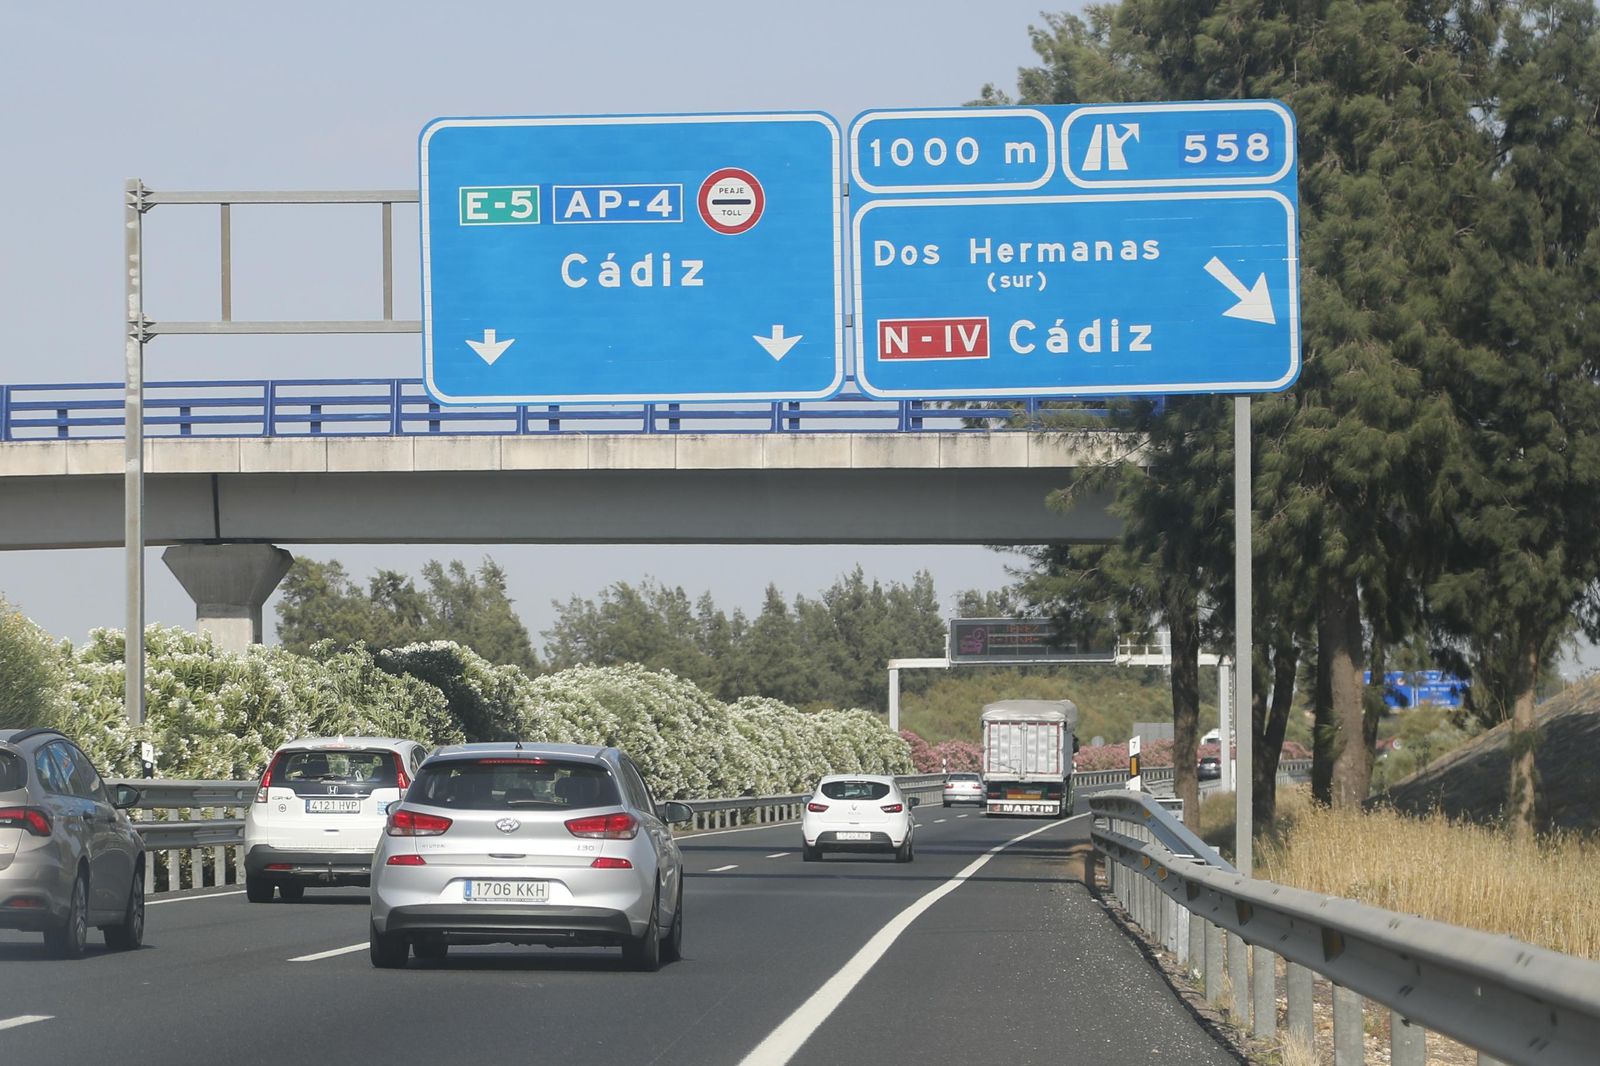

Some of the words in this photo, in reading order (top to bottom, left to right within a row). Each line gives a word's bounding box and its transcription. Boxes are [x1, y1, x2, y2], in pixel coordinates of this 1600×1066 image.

[870, 136, 979, 167] 1000
[1005, 141, 1036, 164] m
[1184, 132, 1270, 164] 558
[466, 190, 534, 220] E-5
[564, 189, 673, 219] AP-4
[718, 186, 745, 195] PEAJE
[721, 208, 743, 217] TOLL
[874, 240, 940, 267] Dos
[970, 237, 1160, 264] Hermanas
[561, 252, 704, 288] Cádiz
[987, 271, 1047, 293] (sur)
[1009, 318, 1152, 354] Cádiz
[311, 800, 336, 810] 4121
[1003, 804, 1054, 813] MARTIN
[476, 882, 512, 896] 1706
[516, 883, 546, 897] KKH
